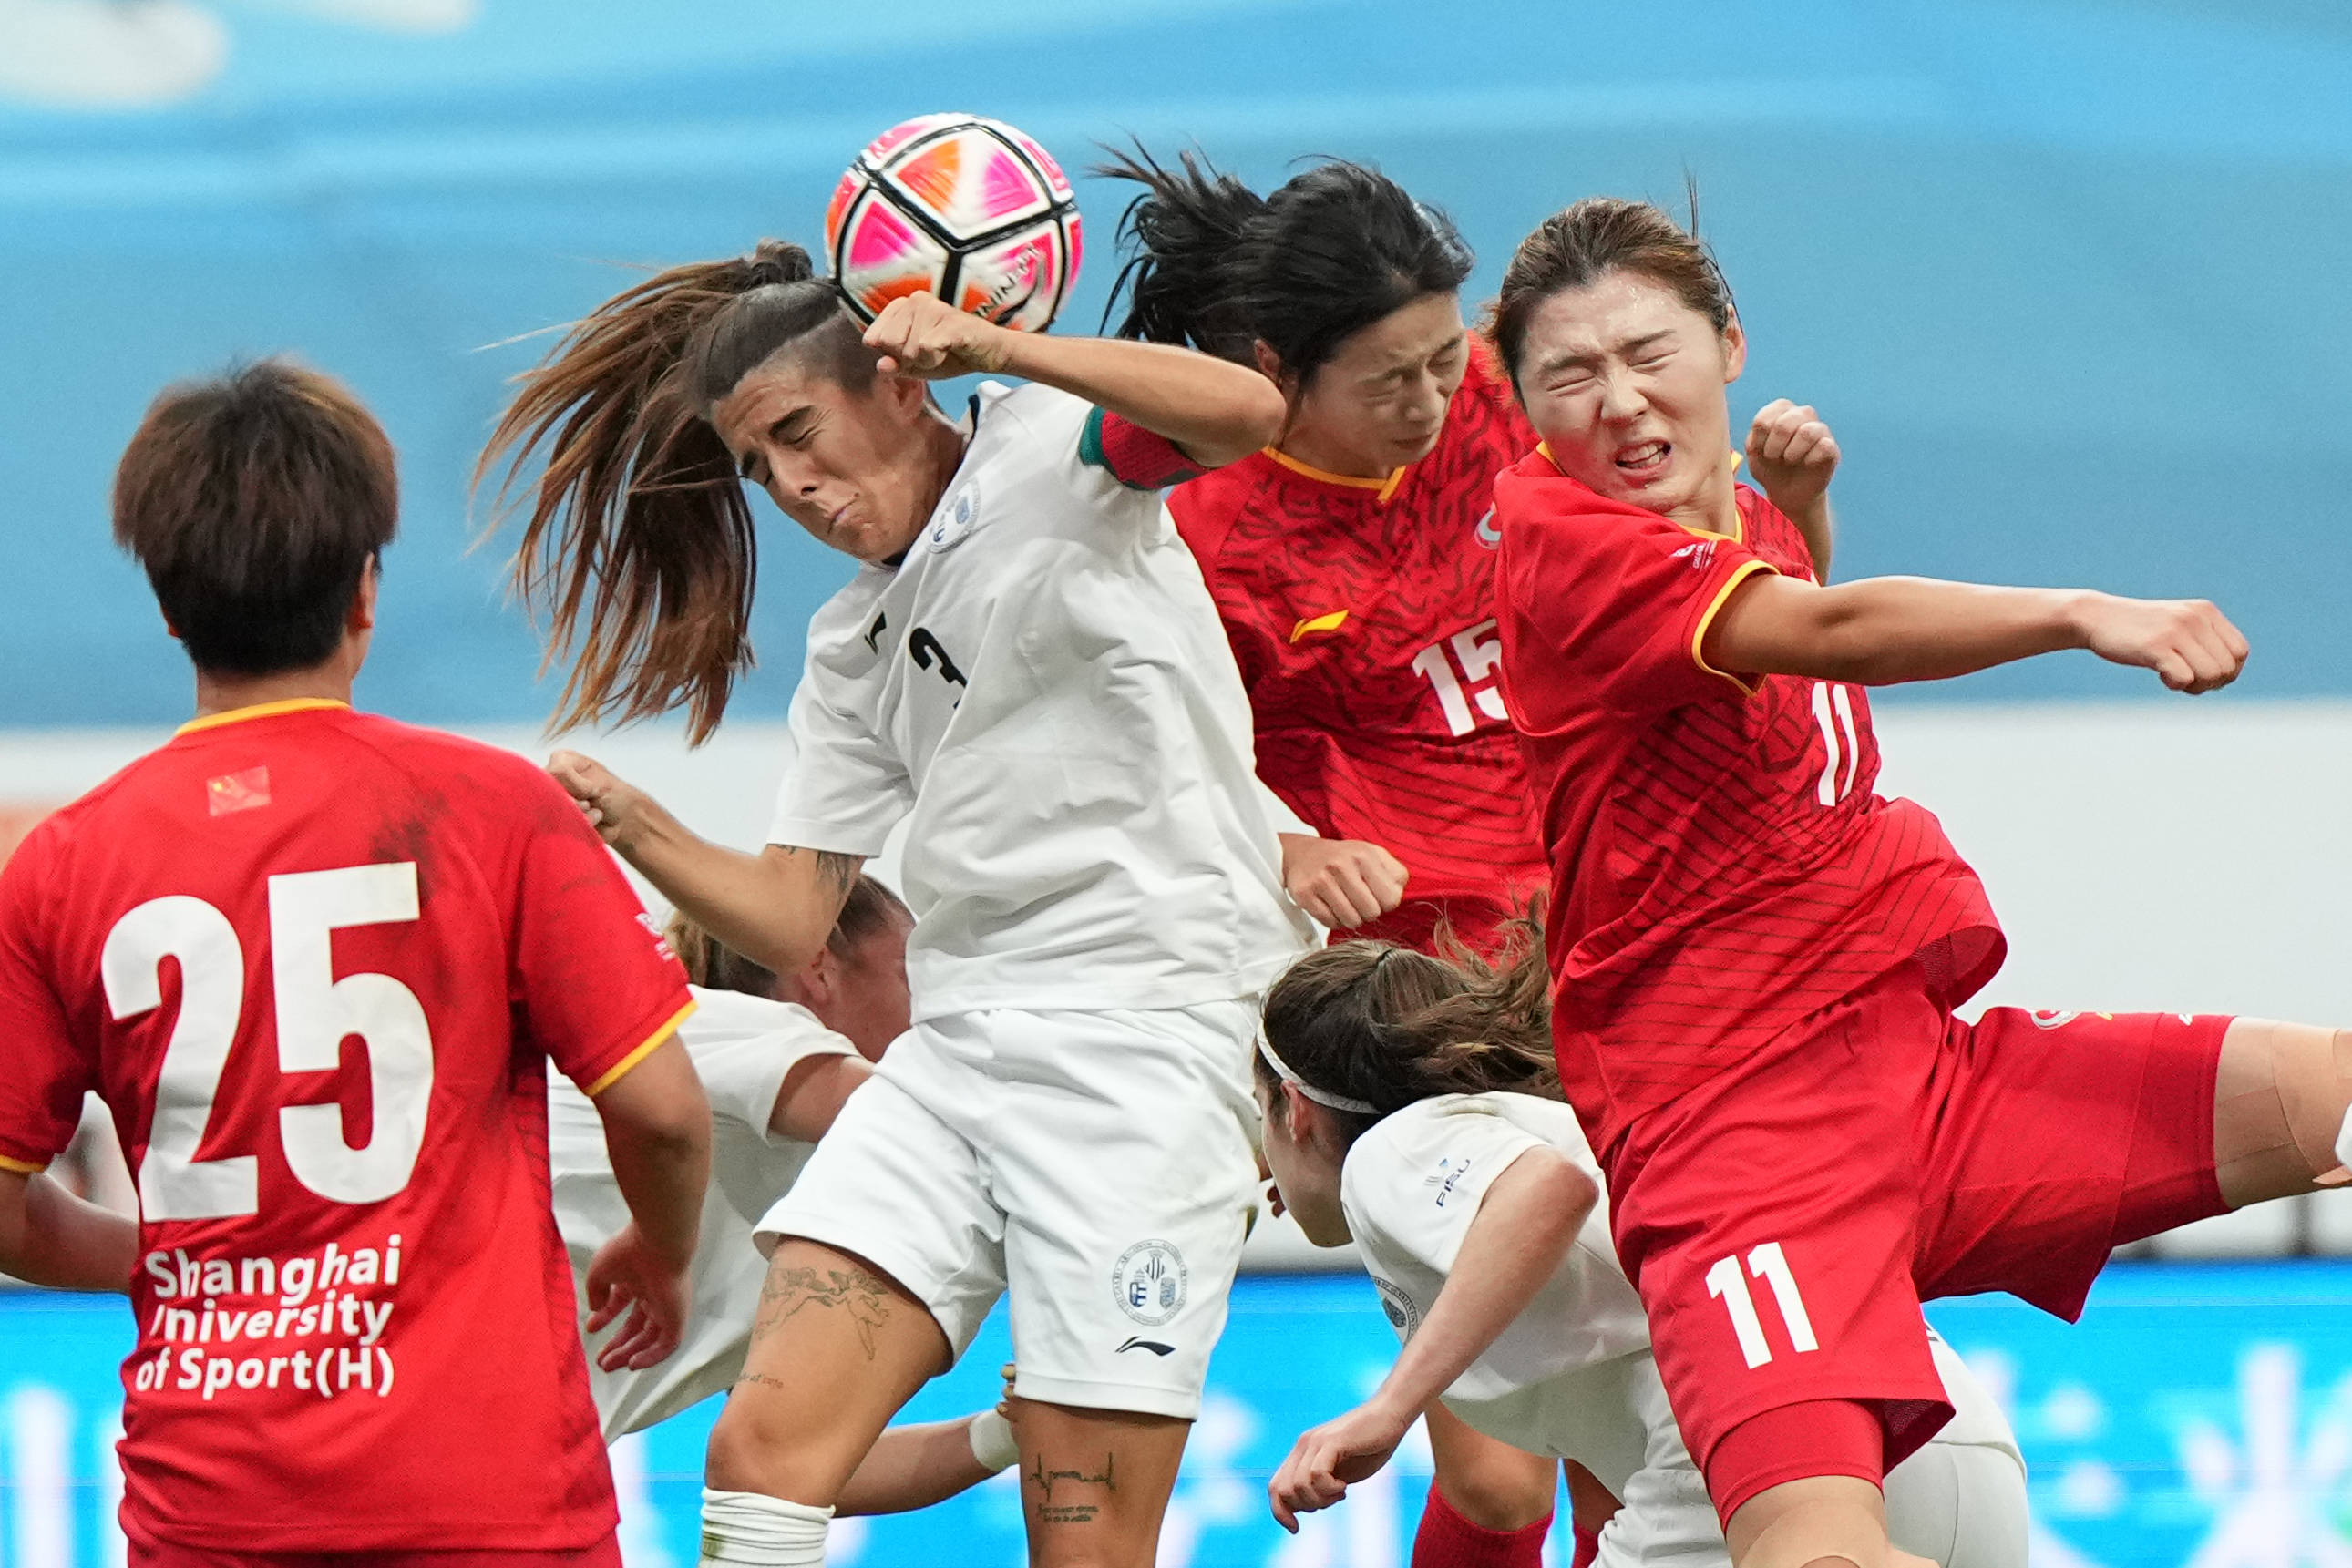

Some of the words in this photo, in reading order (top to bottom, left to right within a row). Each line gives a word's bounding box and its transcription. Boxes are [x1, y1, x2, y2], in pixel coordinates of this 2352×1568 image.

[909, 627, 969, 709] 3
[1412, 618, 1509, 737] 15
[1812, 682, 1859, 807] 11
[100, 861, 435, 1223] 25
[145, 1235, 402, 1306] Shanghai
[1705, 1241, 1819, 1369] 11
[135, 1347, 171, 1392] of
[178, 1347, 395, 1399] Sport(H)
